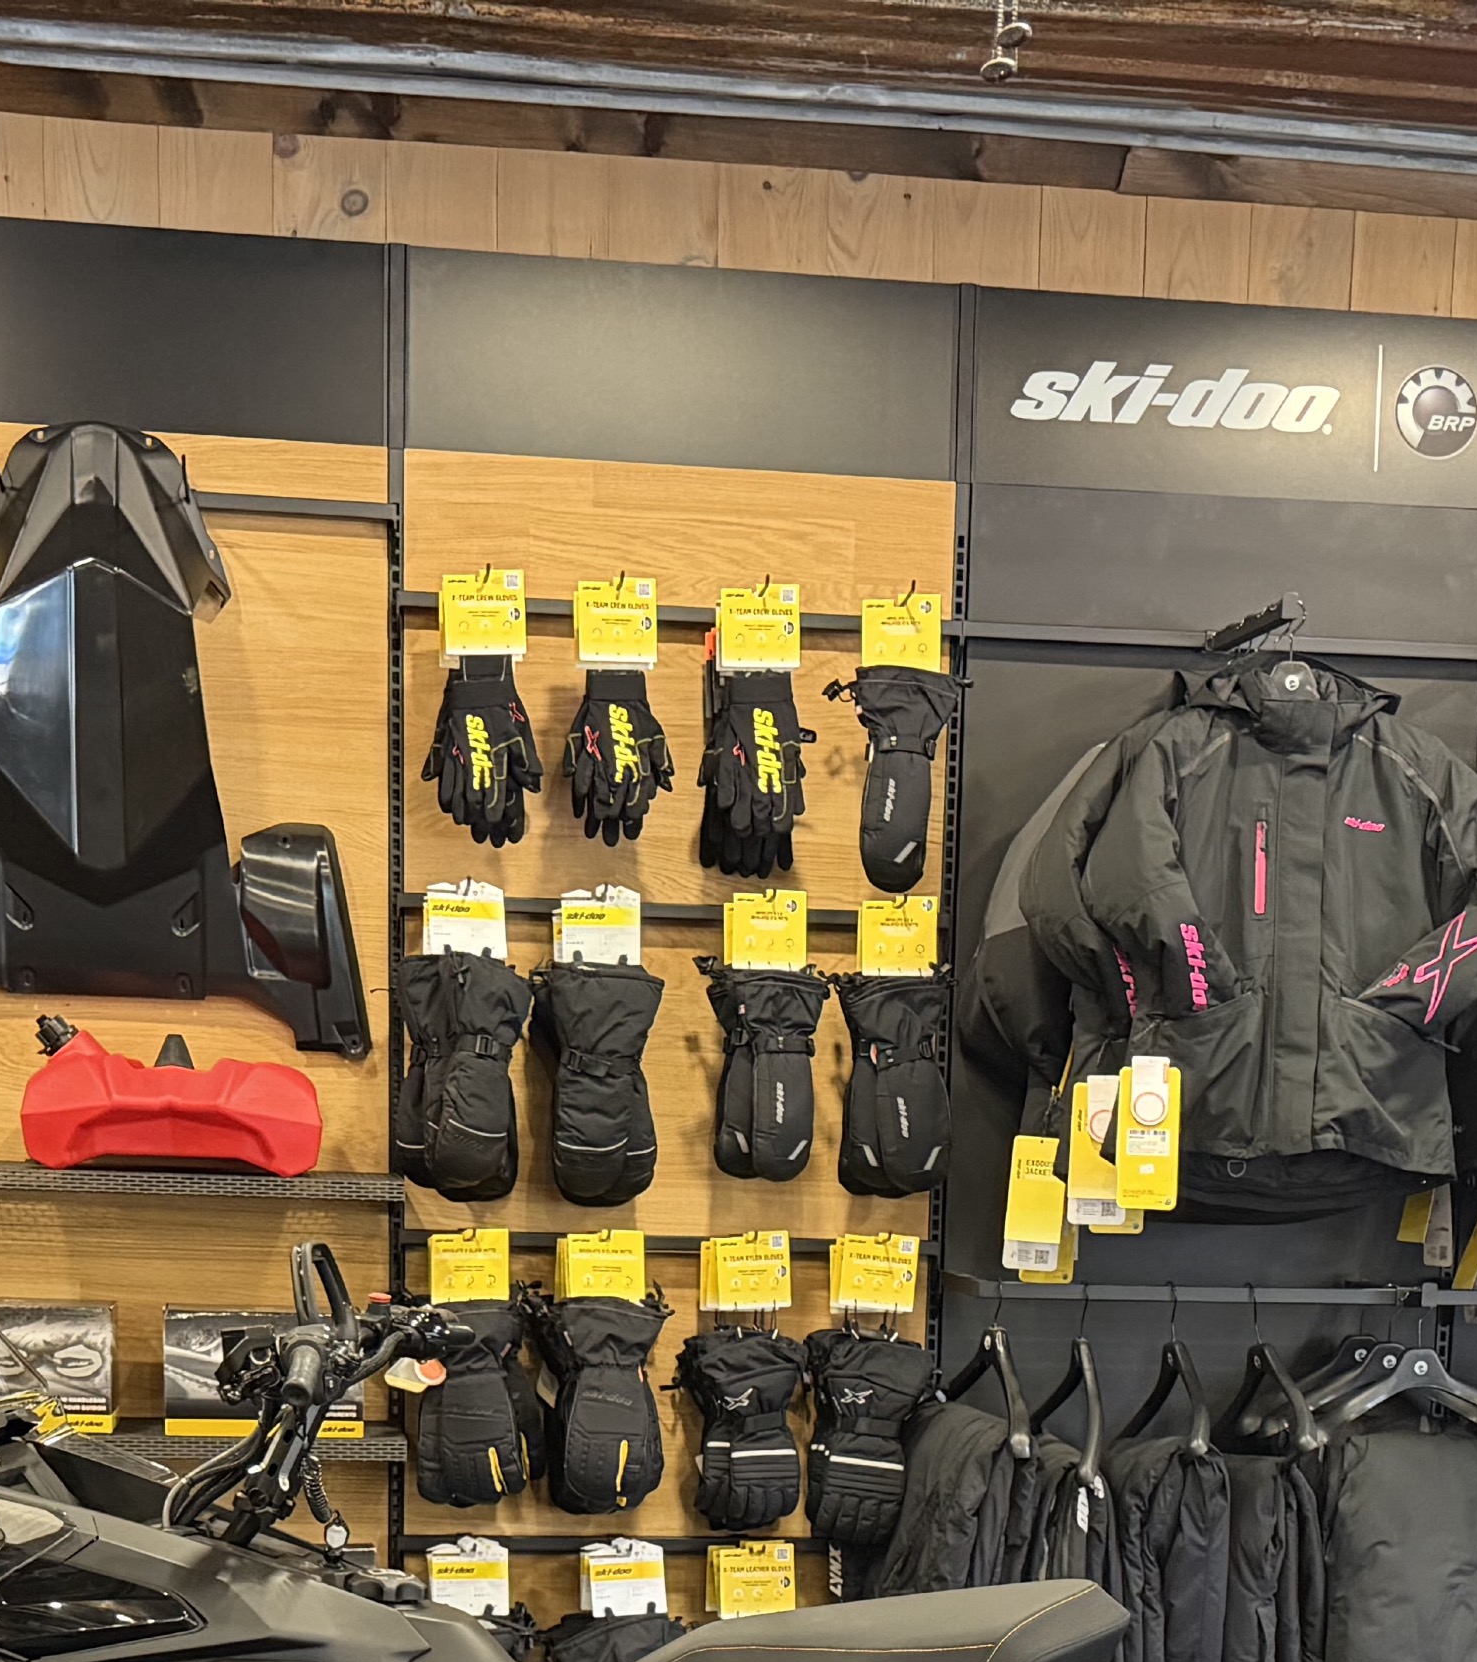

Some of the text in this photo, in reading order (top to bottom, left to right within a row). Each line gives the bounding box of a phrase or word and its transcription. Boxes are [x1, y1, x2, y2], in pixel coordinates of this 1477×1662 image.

[1010, 361, 1340, 434] ski-doo
[1427, 412, 1477, 433] BRP
[432, 904, 470, 913] ski-doo
[566, 912, 606, 921] ski-doo
[436, 1566, 476, 1575] ski-doo
[594, 1567, 633, 1577] ski-doo
[828, 1542, 843, 1598] LYNX
